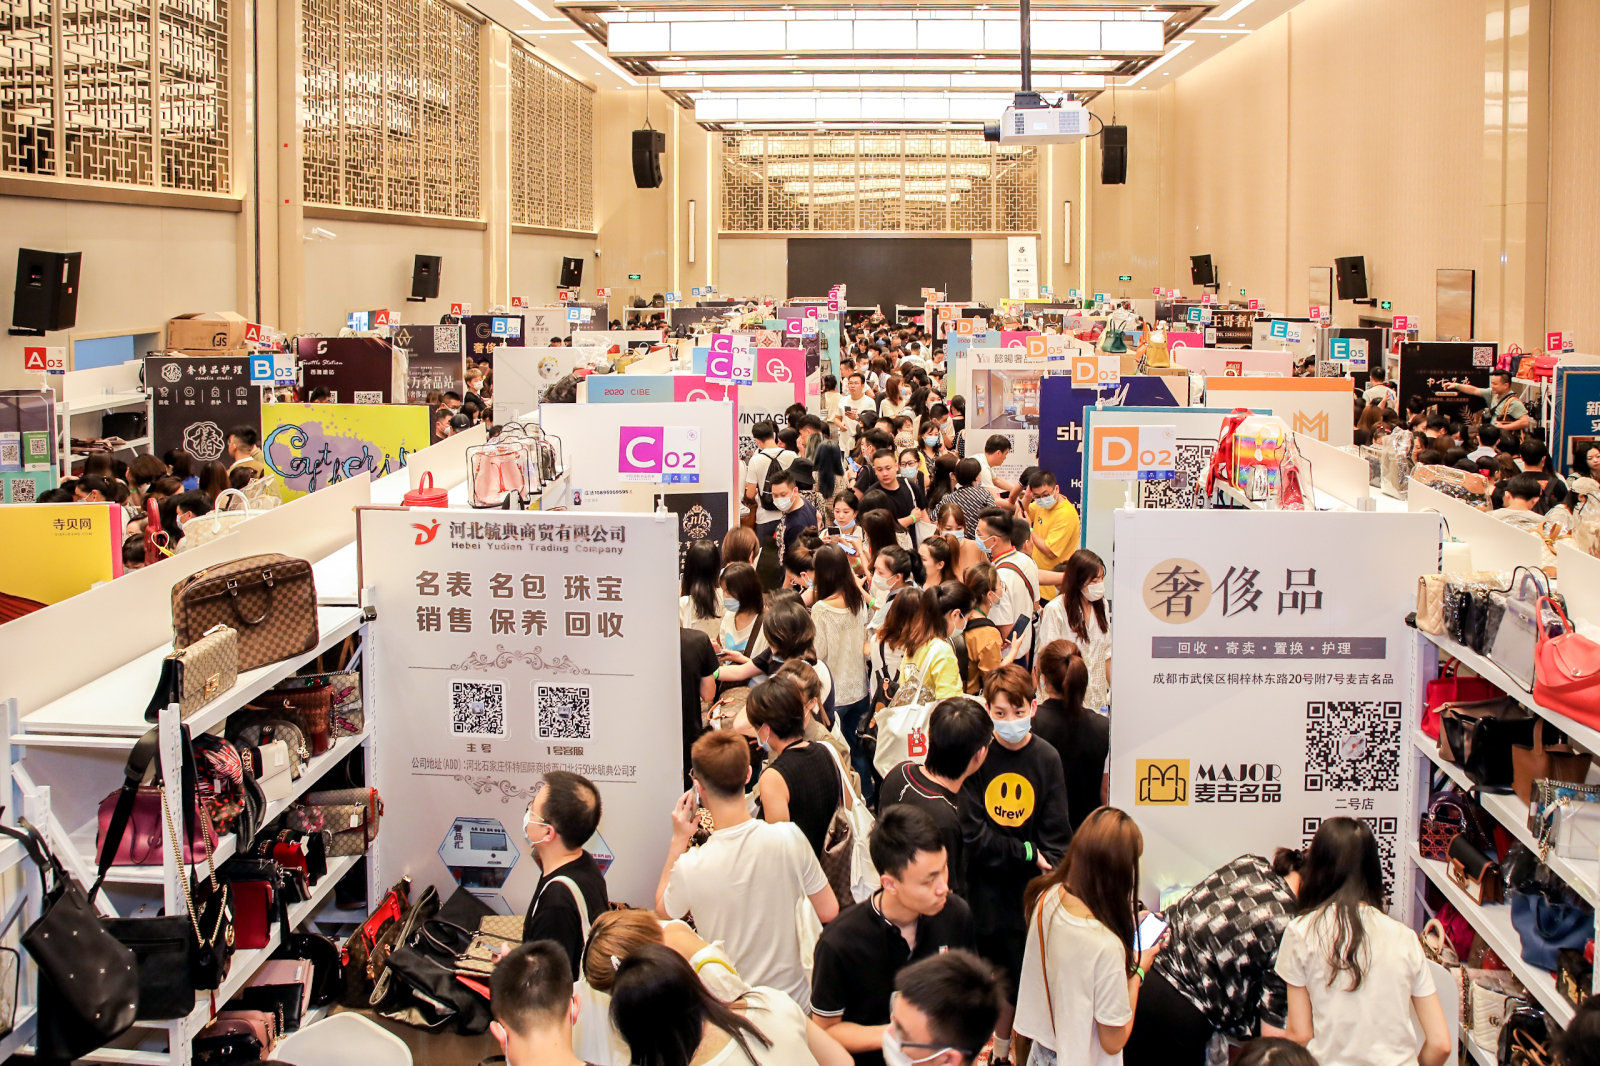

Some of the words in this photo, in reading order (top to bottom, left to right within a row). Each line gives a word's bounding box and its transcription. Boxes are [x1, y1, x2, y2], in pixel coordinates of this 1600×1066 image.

[604, 388, 625, 396] 2020
[630, 388, 651, 396] CIBE
[53, 518, 92, 531] 寺贝网
[450, 521, 626, 543] 河北毓典商贸有限公司
[451, 542, 481, 550] Hebei
[529, 543, 569, 553] Trading
[575, 544, 624, 555] Company
[416, 570, 472, 597] 名表
[490, 572, 547, 600] 名包
[564, 575, 623, 601] 珠宝
[1150, 565, 1323, 618] 奢侈品
[416, 606, 472, 633] 销售
[490, 608, 548, 636] 保养
[565, 611, 624, 638] 回收
[1153, 672, 1394, 686] 成都市武侯区桐梓林东路20号附7号麦吉名品
[546, 746, 584, 756] 1号客服
[1196, 763, 1282, 782] MAJOR
[1195, 783, 1282, 803] 麦吉名品
[1335, 798, 1374, 811] 二号店
[994, 805, 1025, 820] drew
